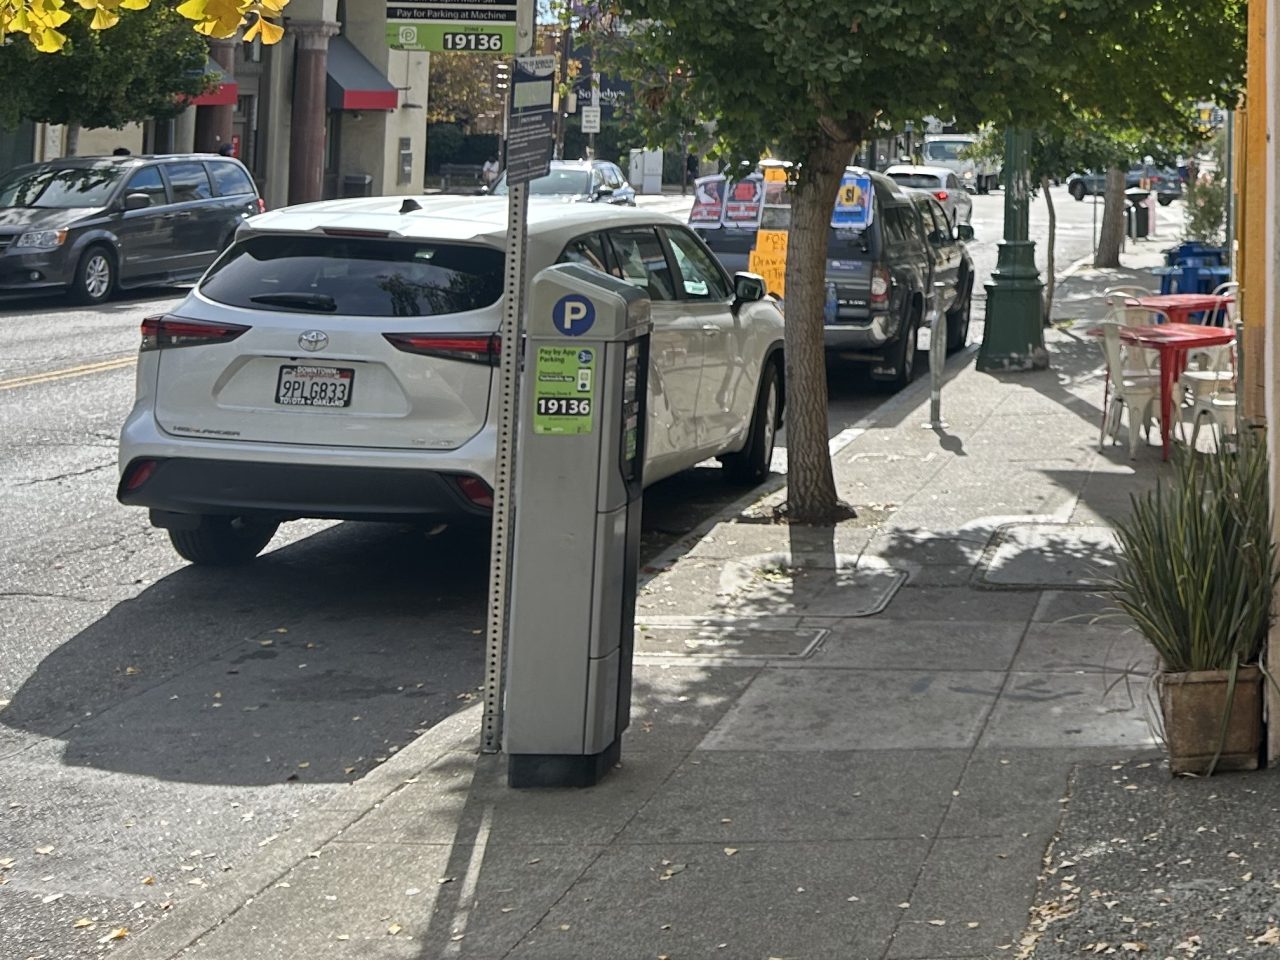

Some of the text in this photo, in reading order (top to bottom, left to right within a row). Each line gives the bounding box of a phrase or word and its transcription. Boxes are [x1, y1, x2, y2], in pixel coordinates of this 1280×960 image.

[396, 9, 412, 18] Pay
[414, 9, 425, 18] for
[427, 10, 459, 19] Parking
[471, 11, 507, 20] Machine
[445, 34, 501, 50] 19136
[563, 301, 587, 329] P
[540, 348, 552, 356] Pay
[553, 348, 562, 356] by
[540, 356, 565, 364] Parking
[283, 380, 346, 400] 9PLG833
[538, 399, 590, 414] 19136
